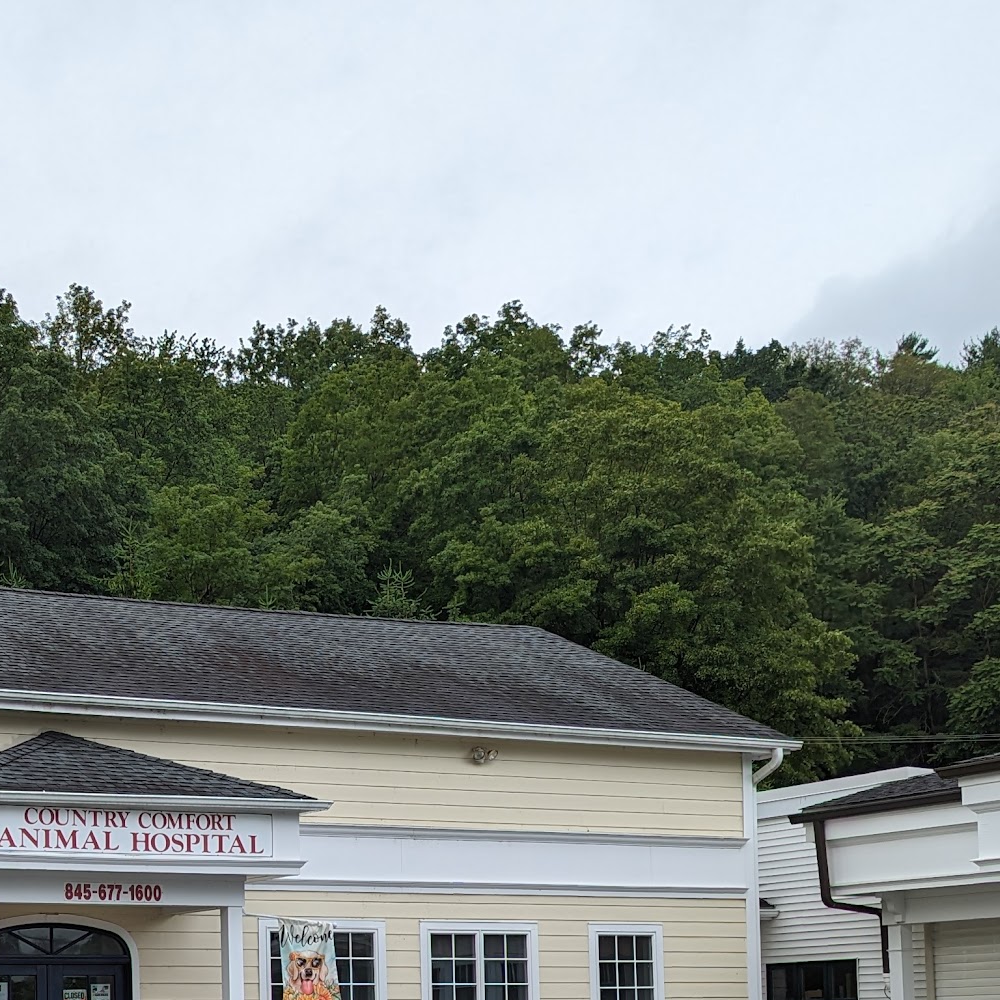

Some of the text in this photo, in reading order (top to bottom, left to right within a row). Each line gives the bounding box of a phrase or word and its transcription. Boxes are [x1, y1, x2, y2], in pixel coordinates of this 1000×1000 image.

[24, 807, 236, 831] COUNTRY COMFORT
[130, 832, 264, 854] HOSPITAL
[64, 883, 162, 901] 845-677-1600
[279, 924, 333, 948] Welcome
[64, 992, 85, 1000] CLOSED
